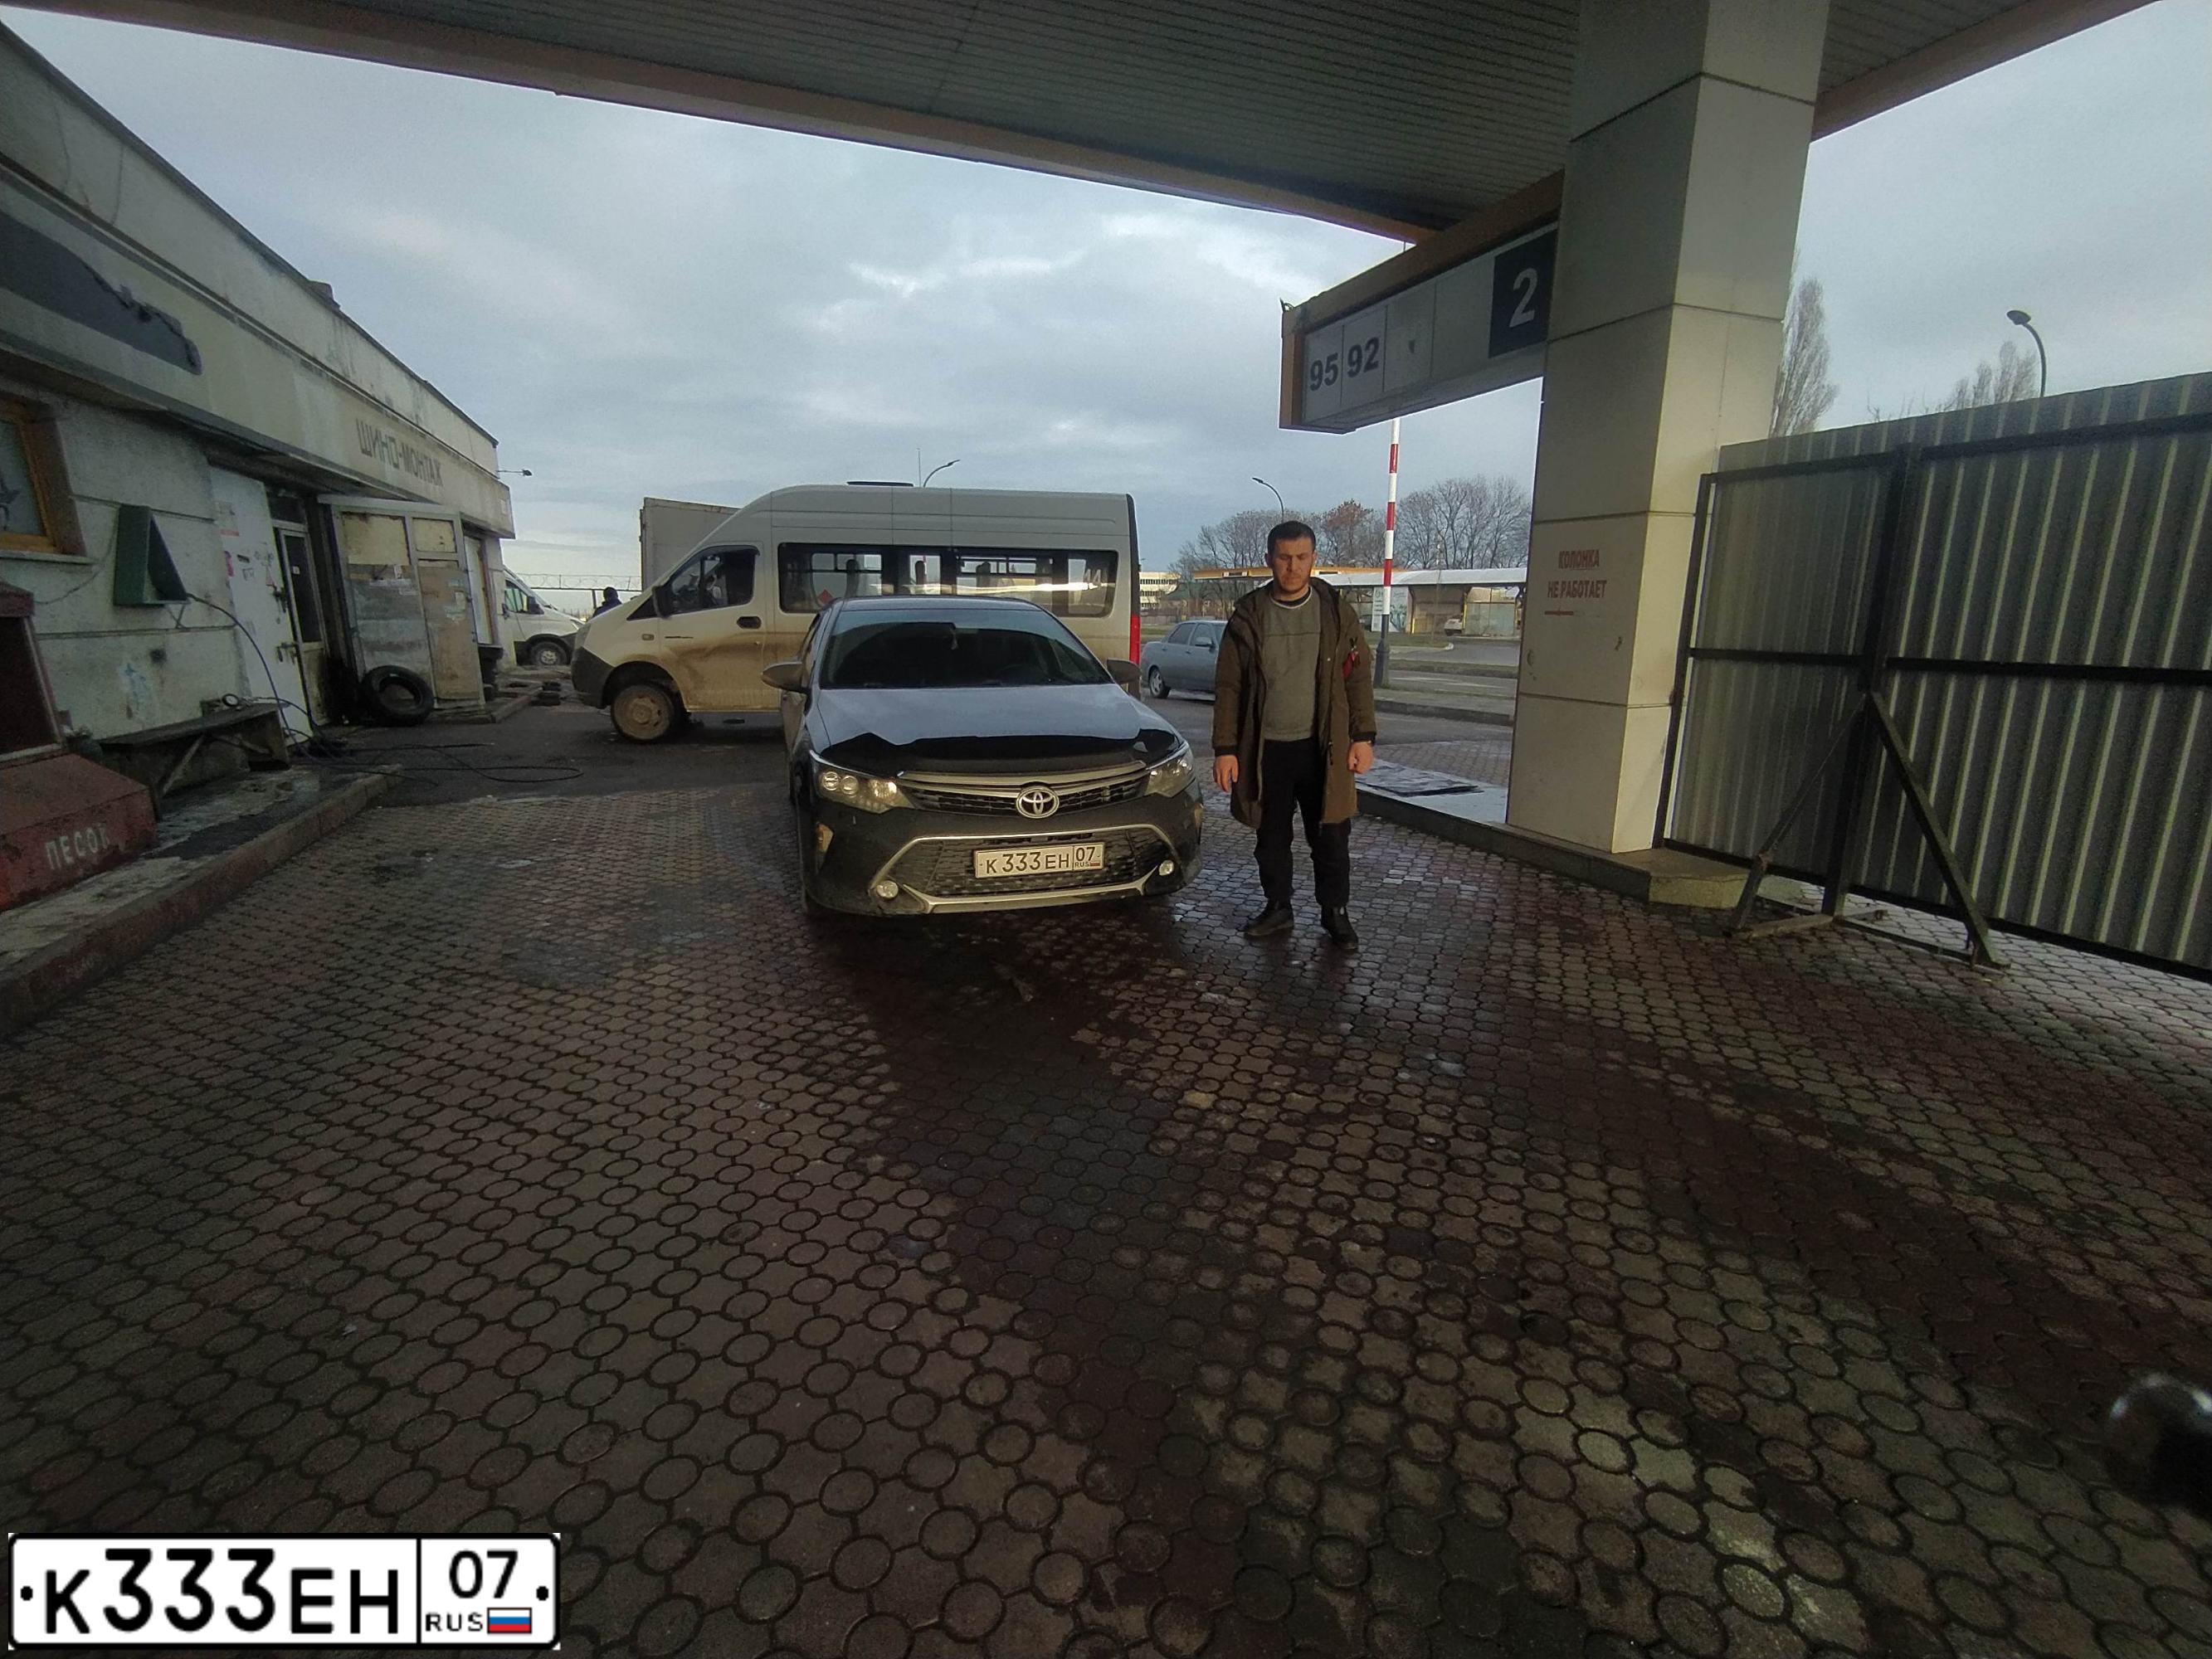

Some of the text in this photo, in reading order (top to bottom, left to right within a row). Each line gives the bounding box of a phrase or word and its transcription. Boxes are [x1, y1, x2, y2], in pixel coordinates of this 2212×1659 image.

[1509, 267, 1538, 328] 2
[1309, 337, 1381, 392] 95 92
[1547, 580, 1607, 598] НЕ РАБОТАЕТ
[1075, 846, 1096, 862] 07
